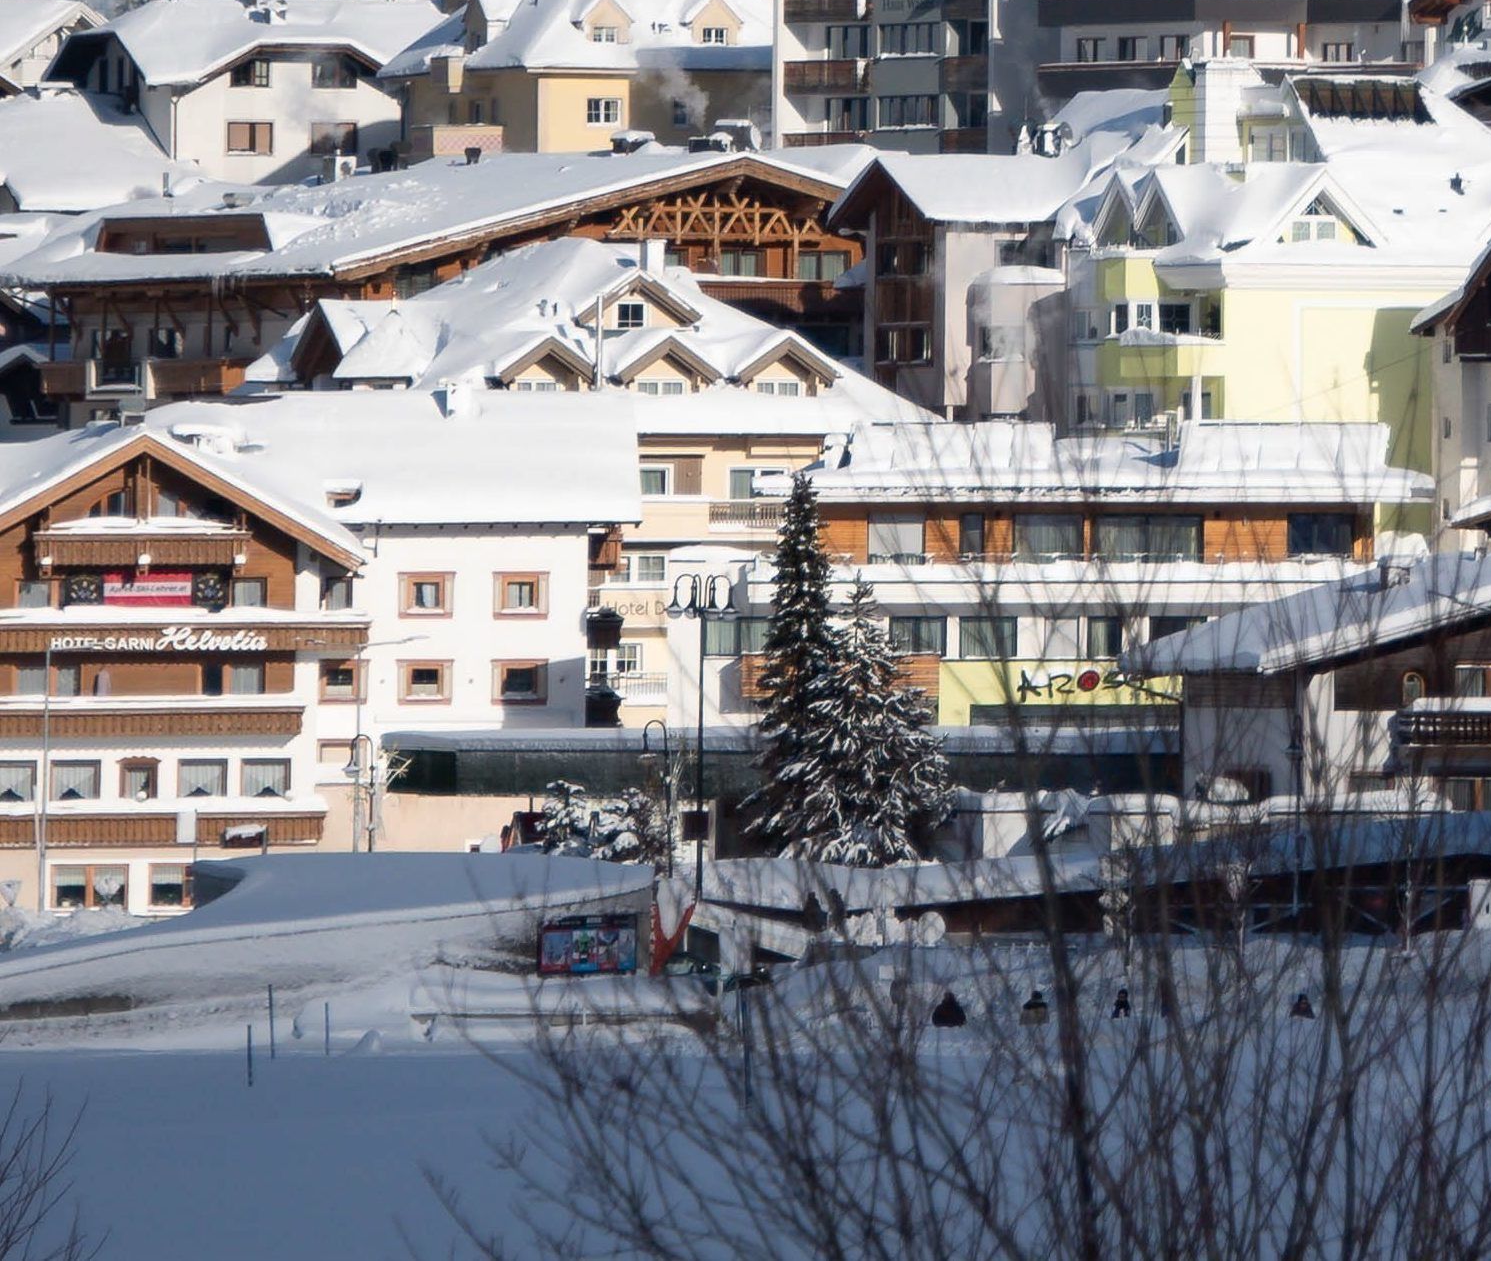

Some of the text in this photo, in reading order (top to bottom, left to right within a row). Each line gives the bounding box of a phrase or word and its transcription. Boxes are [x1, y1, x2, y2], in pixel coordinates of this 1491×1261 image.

[606, 599, 649, 616] Hotel
[50, 626, 268, 651] HOTEL GARNI Helvetia
